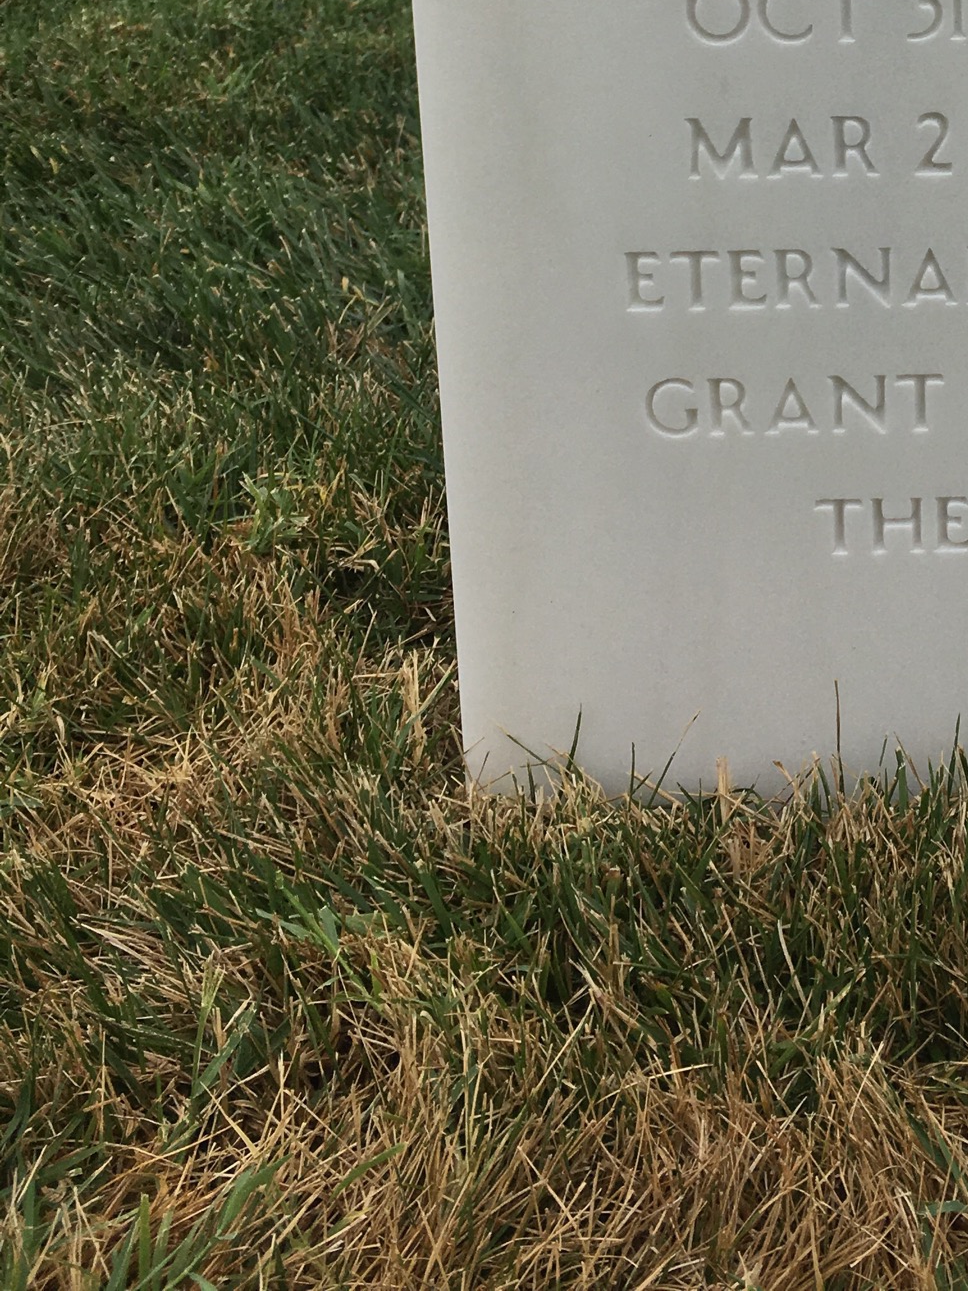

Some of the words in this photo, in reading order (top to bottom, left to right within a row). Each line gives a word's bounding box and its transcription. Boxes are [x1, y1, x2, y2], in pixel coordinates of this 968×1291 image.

[685, 114, 880, 181] MAR
[913, 111, 953, 177] 2
[645, 371, 945, 438] GRANT
